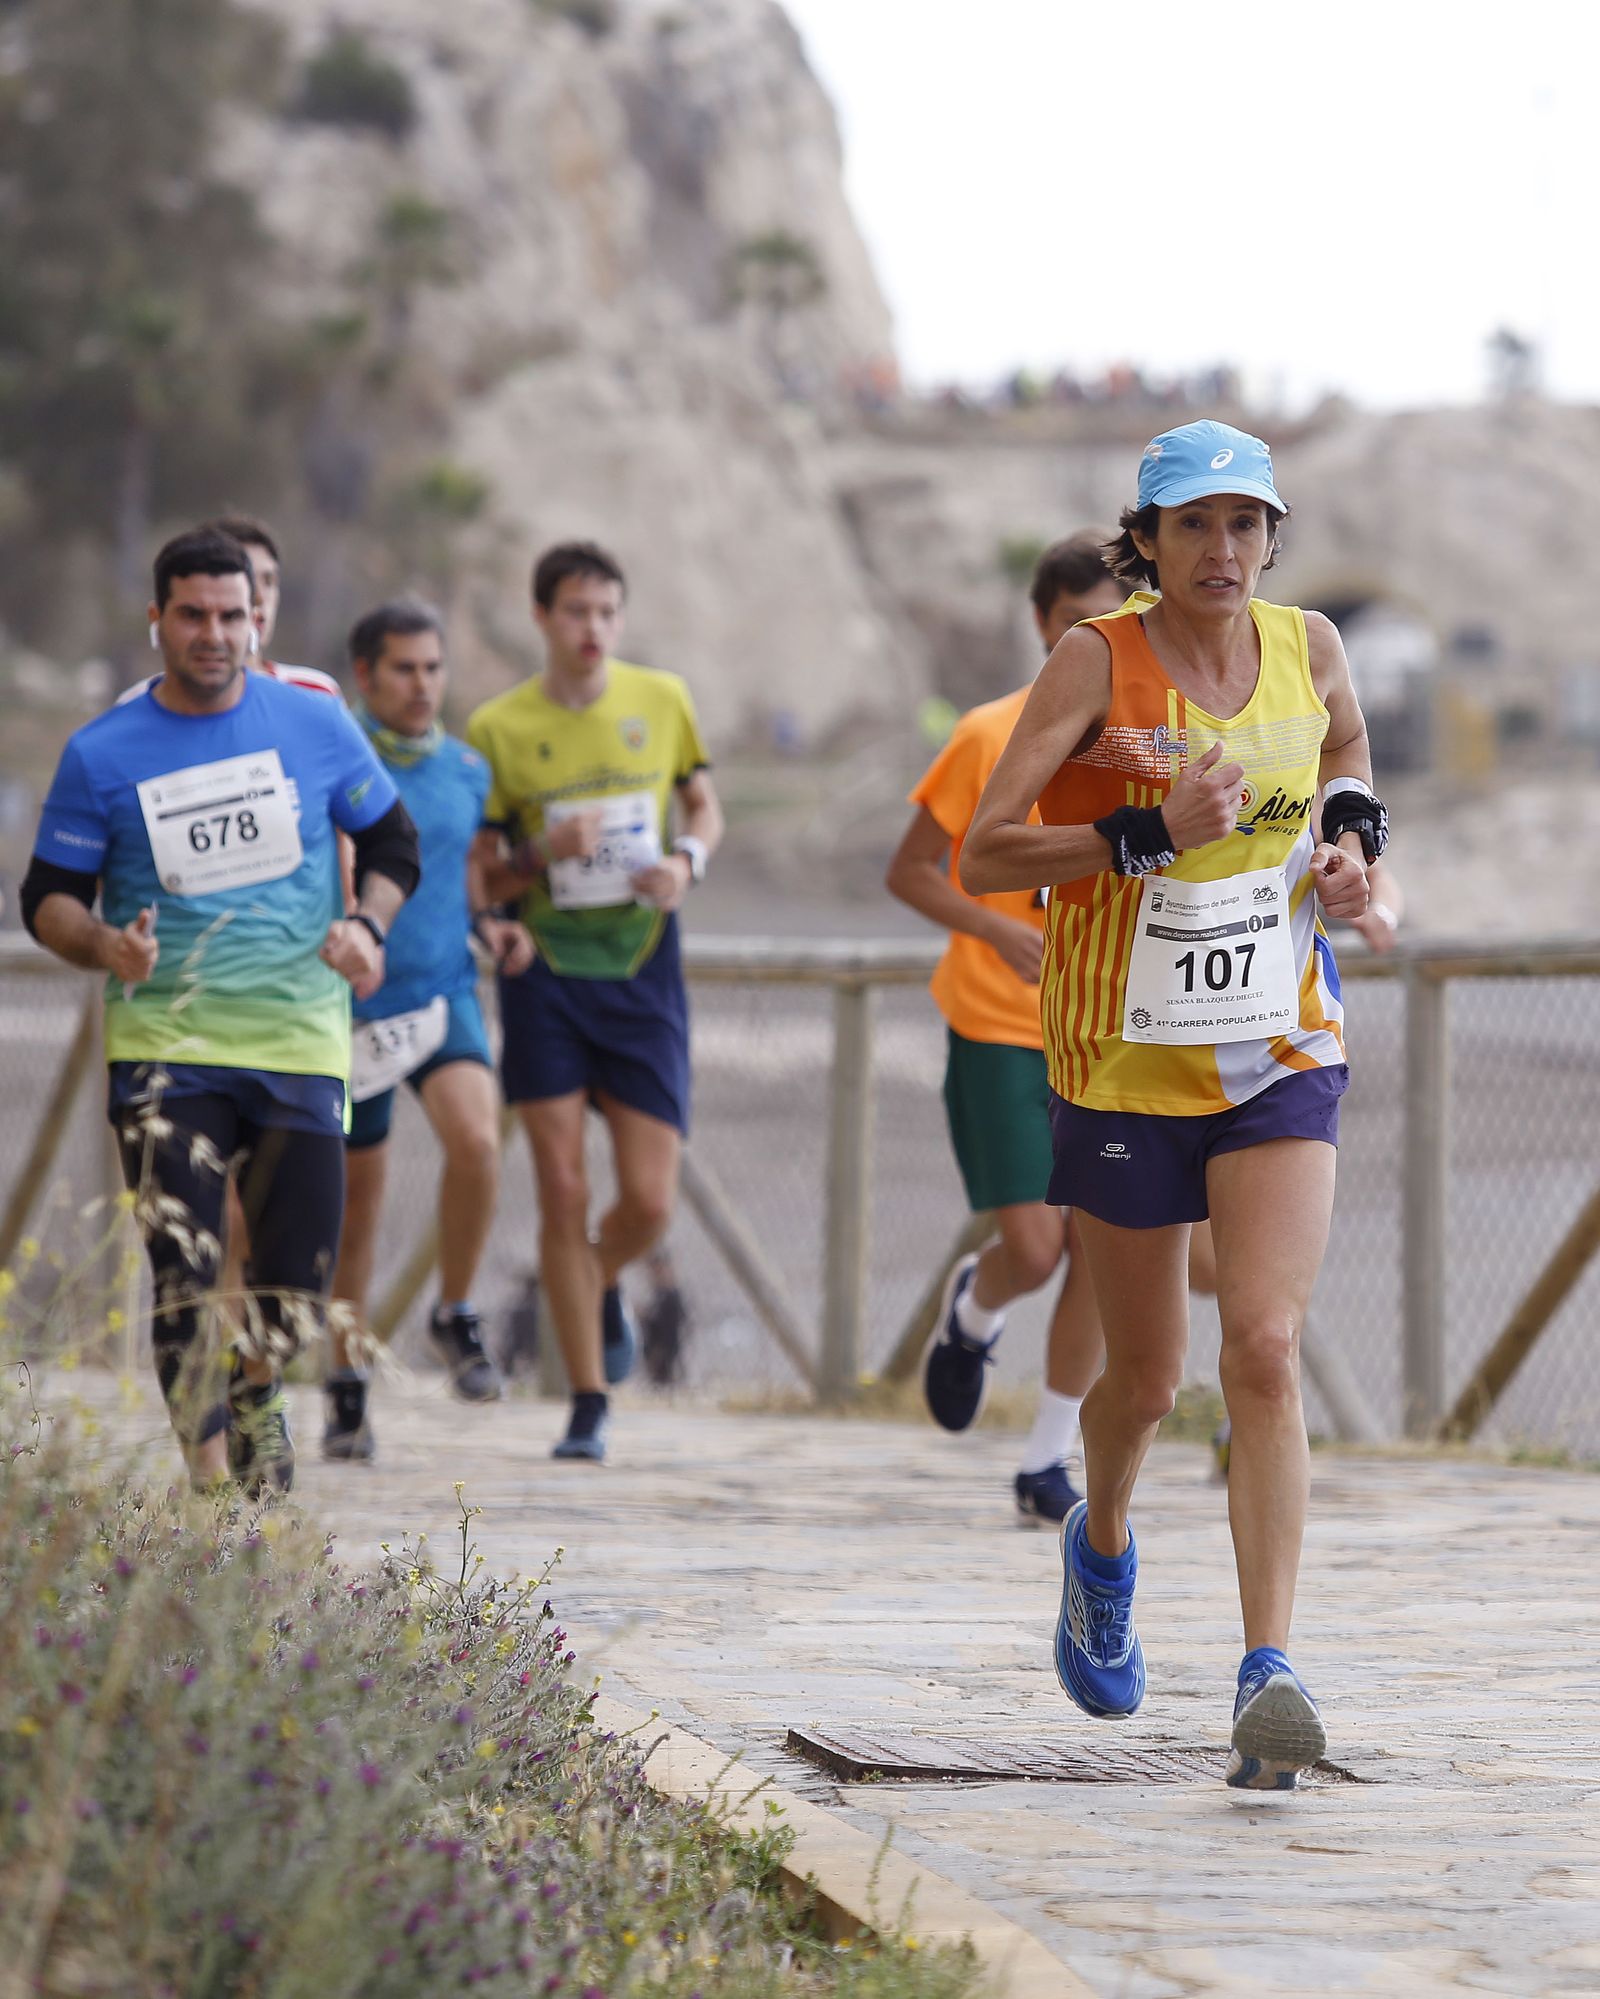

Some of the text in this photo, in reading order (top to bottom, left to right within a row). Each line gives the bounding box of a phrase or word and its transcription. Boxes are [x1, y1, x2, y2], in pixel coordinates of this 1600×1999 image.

[1118, 726, 1153, 734] ATLETISMO
[188, 810, 259, 852] 678
[1264, 825, 1299, 836] Málaga
[1165, 899, 1210, 912] Ayuntamiento
[1210, 899, 1219, 908] de
[1175, 943, 1256, 992] 107
[1166, 998, 1195, 1006] SUSANA
[1195, 996, 1236, 1004] BLAZQUEZ
[1170, 1019, 1214, 1028] CARRERA
[1216, 1015, 1257, 1026] POPULAR
[1258, 1013, 1268, 1021] EL
[1269, 1008, 1290, 1018] PALO
[1099, 1151, 1131, 1161] Kalenji
